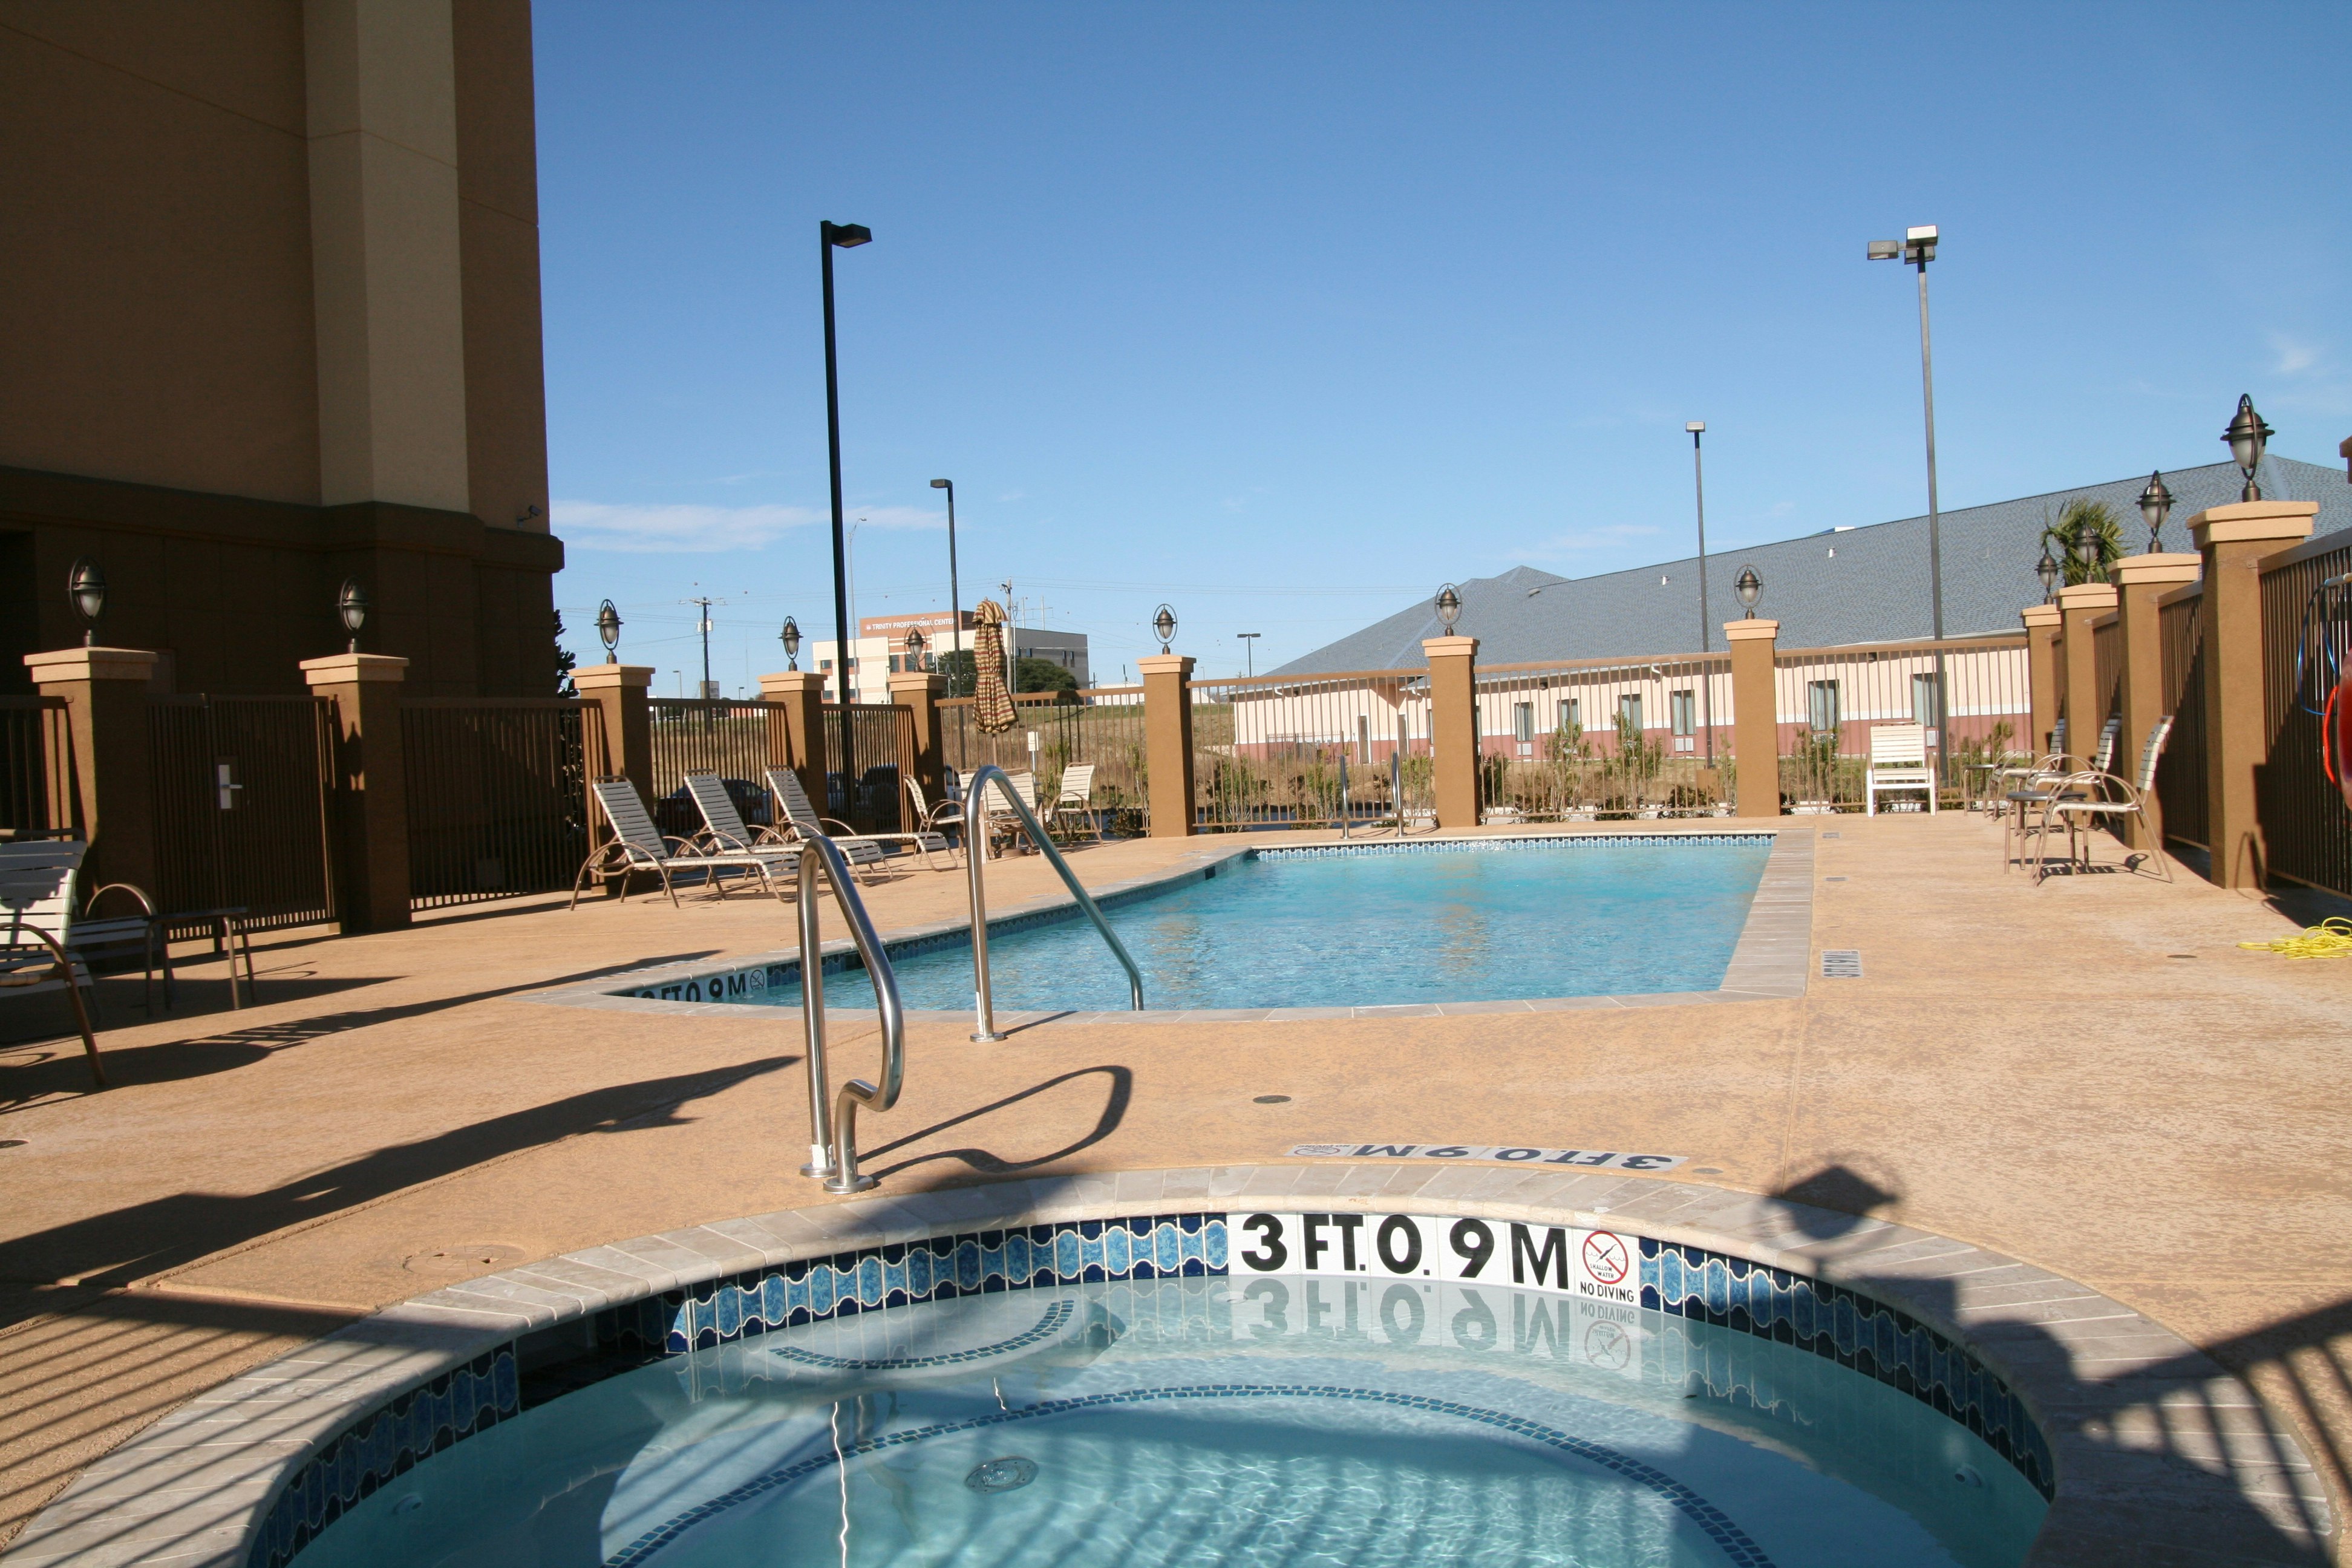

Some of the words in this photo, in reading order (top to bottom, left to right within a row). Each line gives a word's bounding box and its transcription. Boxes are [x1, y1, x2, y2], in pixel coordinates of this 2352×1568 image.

[893, 619, 933, 629] PROFESSIONAL
[728, 973, 746, 996] M
[1352, 1145, 1417, 1157] M
[1620, 1155, 1672, 1170] 3
[1241, 1213, 1288, 1272] 3
[1302, 1214, 1367, 1271] FT.
[1511, 1223, 1569, 1290] M
[1590, 1263, 1612, 1272] SHALLOW
[1580, 1281, 1595, 1296] NO
[1597, 1284, 1635, 1302] DIVING
